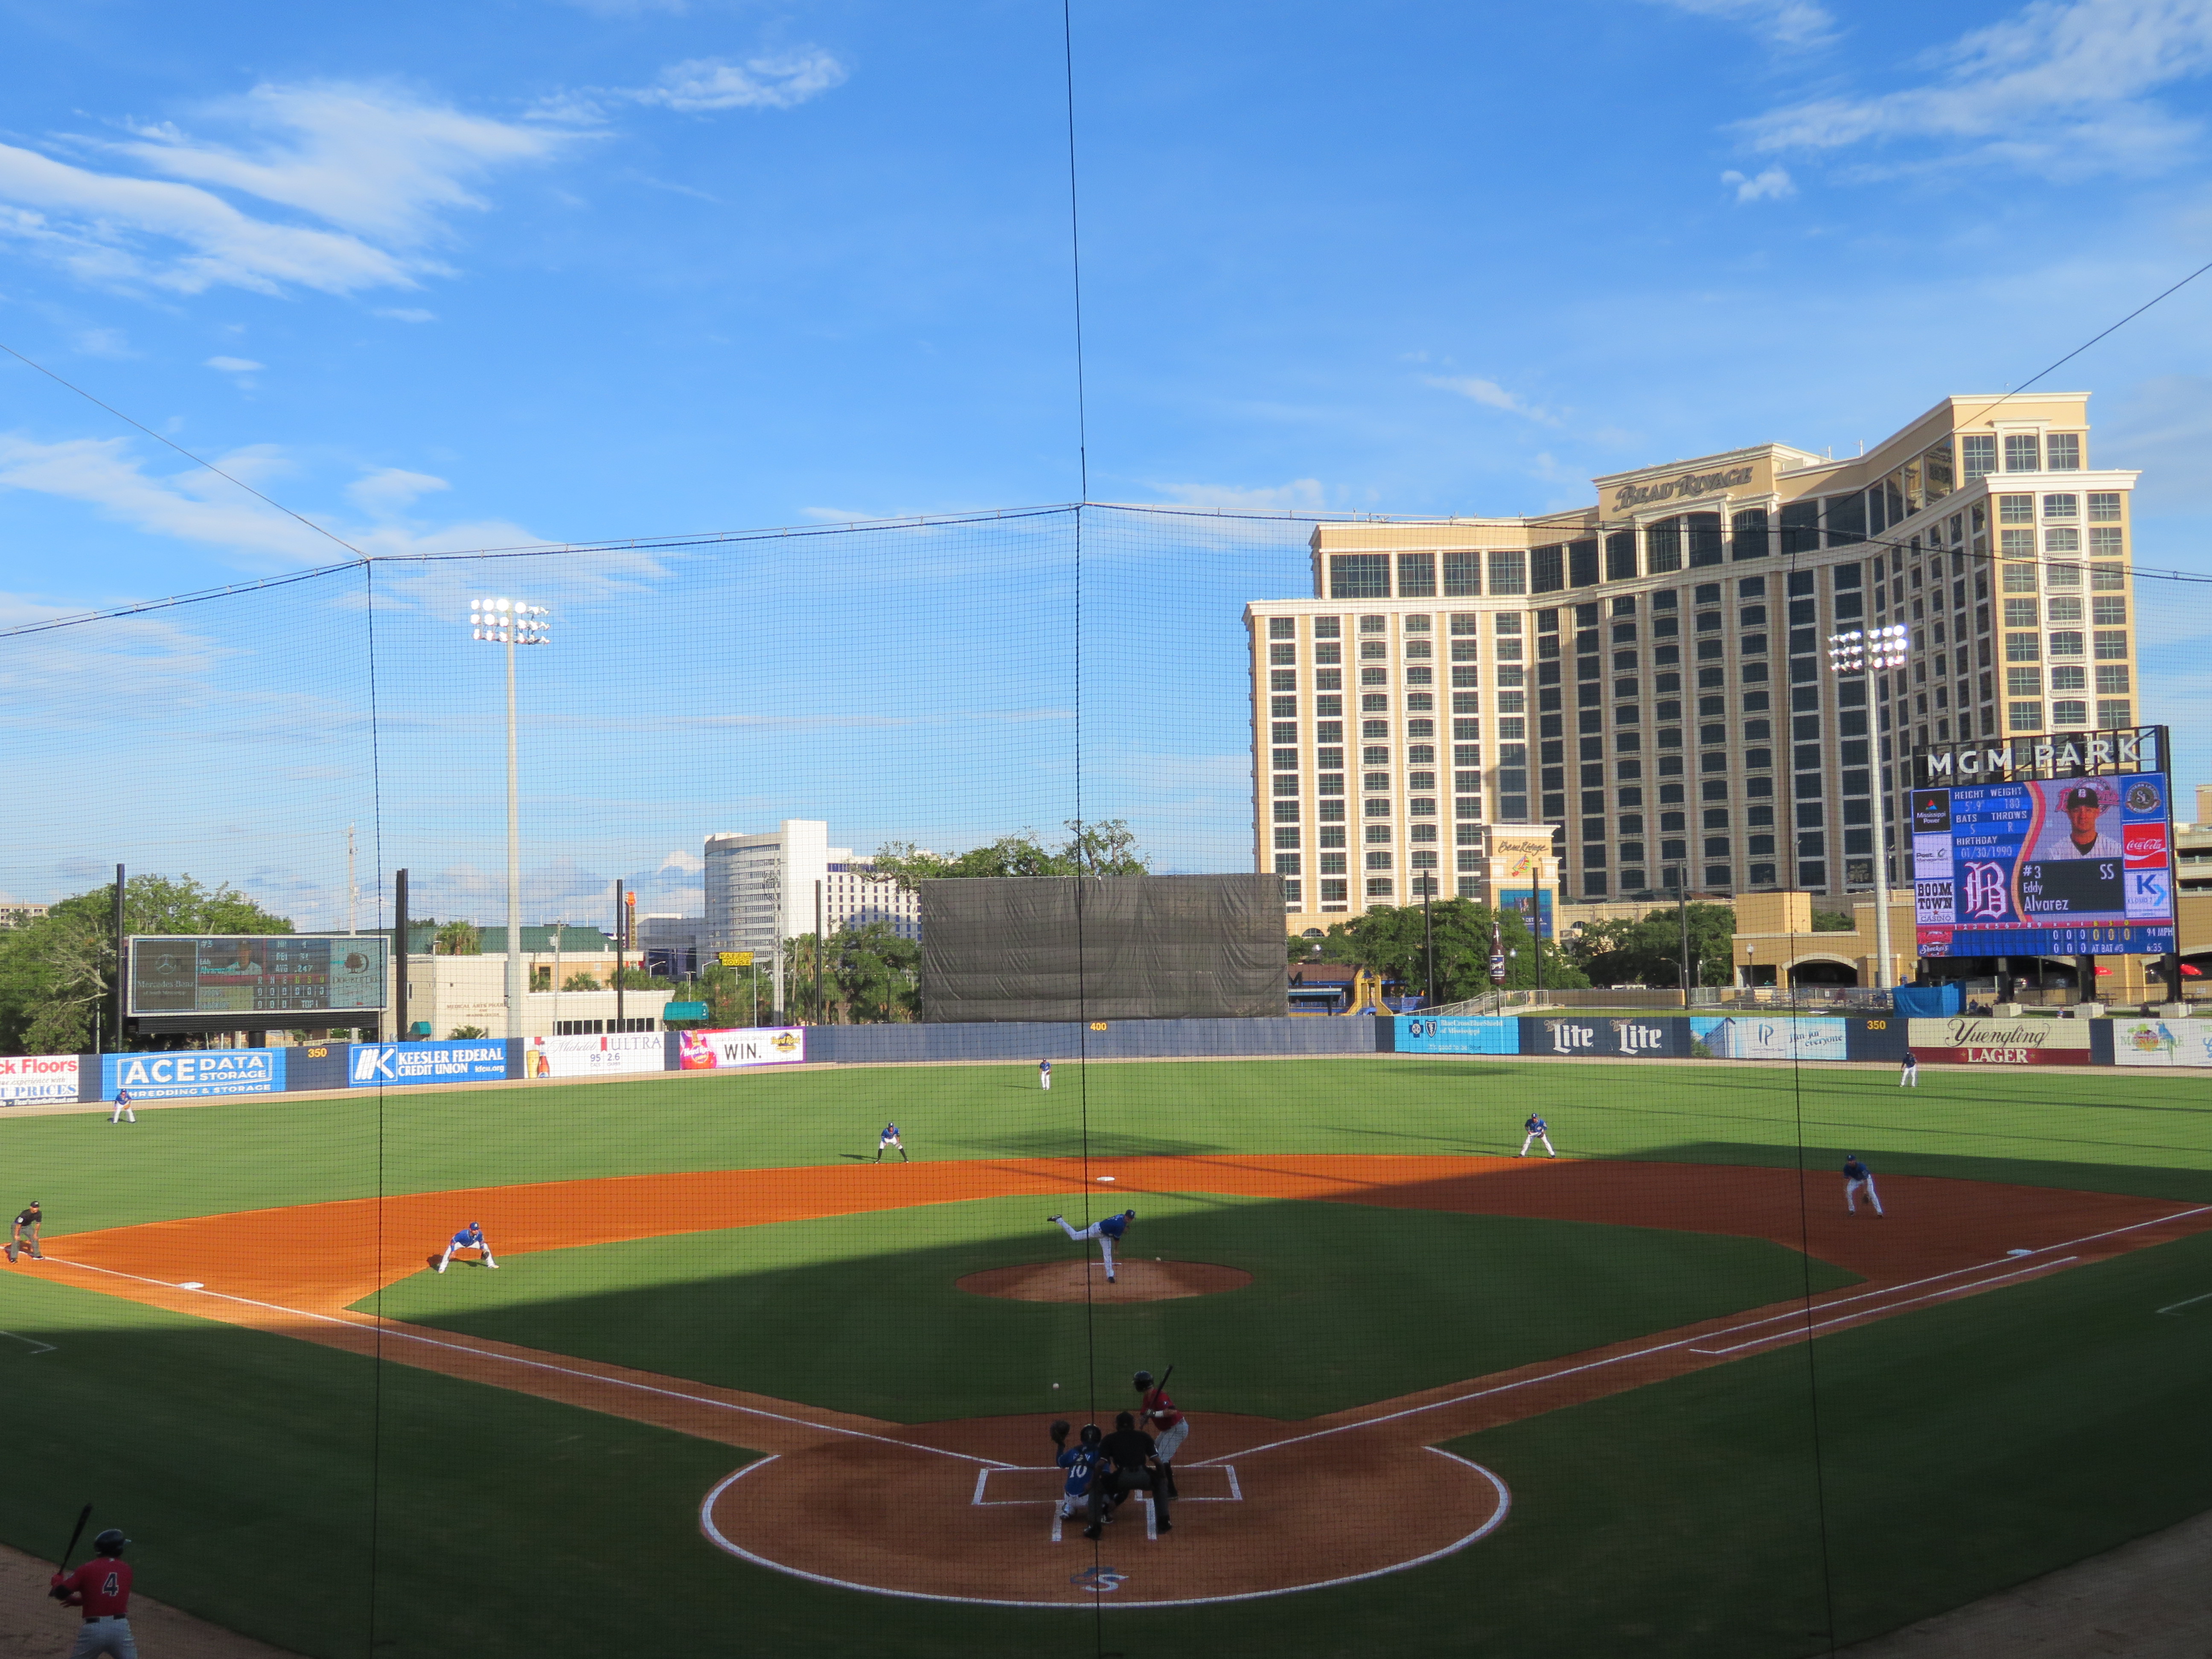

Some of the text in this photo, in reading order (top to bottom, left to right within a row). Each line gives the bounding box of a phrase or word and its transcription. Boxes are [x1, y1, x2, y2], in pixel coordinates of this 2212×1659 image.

[1612, 466, 1753, 512] BEAU RIVAGE
[1928, 737, 2141, 777] MGM PARK
[1954, 787, 2022, 800] HEIGHT WEIGHT
[2005, 798, 2020, 809] 180
[1956, 810, 2027, 823] BATS THROWS
[1970, 821, 2014, 835] S R
[1956, 835, 1998, 846] BIRTHDAY
[2126, 838, 2163, 851] Coca-Cola
[1961, 846, 2013, 859] 01/30/1990
[2099, 863, 2114, 880] SS
[1918, 883, 1953, 896] BOOM
[2023, 881, 2043, 895] Eddy
[1918, 897, 1953, 909] TOWN
[2024, 895, 2069, 911] Alvarez
[2053, 930, 2058, 940] 0
[2066, 929, 2072, 940] 0
[2080, 929, 2085, 939] 0
[2093, 928, 2099, 940] 0
[2108, 928, 2115, 940] 0
[2124, 928, 2131, 940] 0
[2157, 927, 2173, 937] MPH
[1920, 944, 1949, 954] Shuckers
[2054, 943, 2162, 953] 0 0 0 AT BAT #3 6:35
[276, 964, 314, 973] AVG .247
[258, 987, 263, 996] 0
[270, 987, 275, 996] 0
[282, 987, 287, 995] 0
[295, 987, 300, 995] 0
[307, 987, 312, 995] 0
[320, 987, 325, 995] 0
[258, 1000, 263, 1009] 0
[270, 1000, 275, 1009] 0
[282, 1000, 287, 1008] 0
[1090, 1022, 1107, 1031] 400
[1448, 1027, 1480, 1036] Mississippi
[1544, 1019, 1566, 1032] Miller
[1610, 1019, 1633, 1032] Miller
[1867, 1020, 1886, 1030] 350
[1552, 1024, 1594, 1053] Lite
[1618, 1024, 1662, 1054] Lite
[1945, 1018, 2051, 1048] Yuengling
[548, 1036, 662, 1054] Michelob ULTRA
[771, 1035, 800, 1045] Hard Rock
[1805, 1034, 1843, 1047] everyone
[307, 1047, 328, 1058] 350
[398, 1048, 504, 1065] KEESLER FEDERAL
[607, 1053, 620, 1061] 2.6
[684, 1048, 699, 1057] Hard
[724, 1043, 762, 1060] WIN.
[1968, 1048, 2029, 1063] LAGER
[22, 1059, 78, 1074] Floors
[200, 1056, 265, 1071] DATA
[398, 1063, 505, 1077] CREDIT UNION kfcu.org
[125, 1058, 196, 1084] ACE
[199, 1069, 267, 1081] STORAGE
[10, 1078, 49, 1088] experience
[15, 1084, 76, 1097] PRICES
[126, 1088, 198, 1098] HREDDING
[214, 1084, 271, 1093] STORAGE
[1069, 1465, 1088, 1478] 10
[102, 1572, 119, 1597] 4
